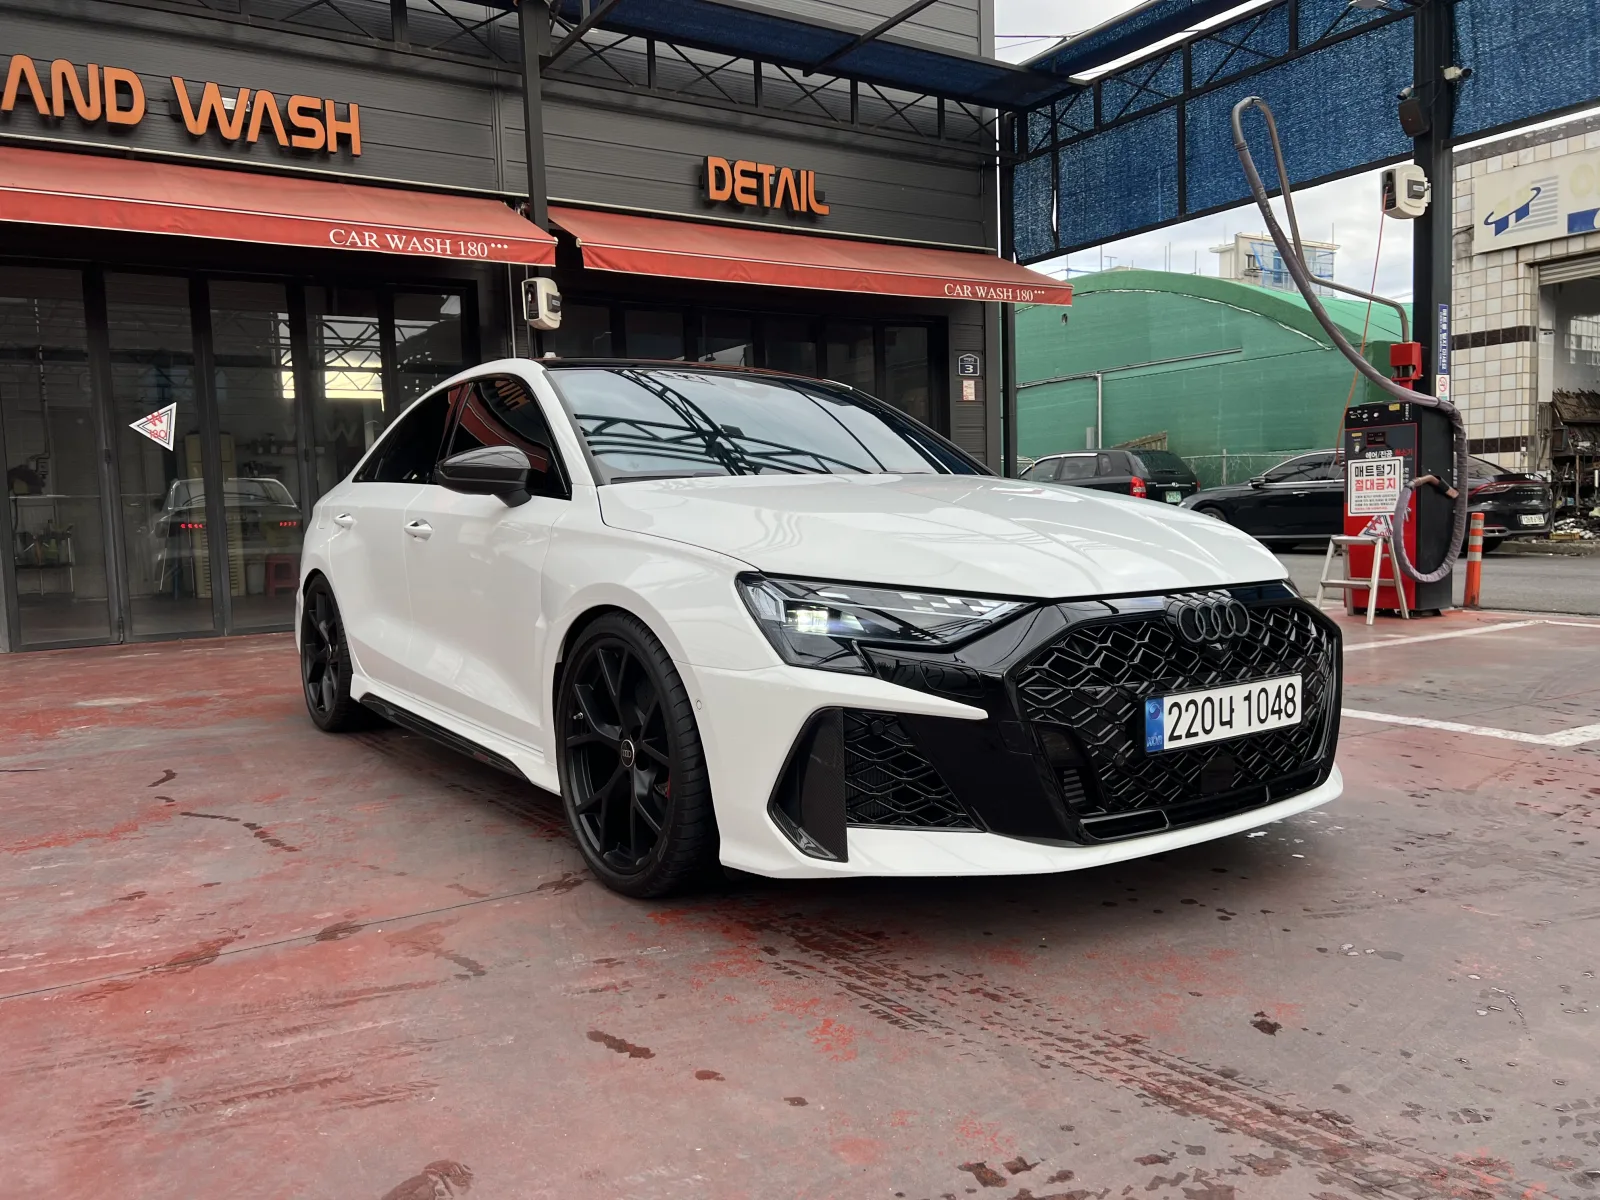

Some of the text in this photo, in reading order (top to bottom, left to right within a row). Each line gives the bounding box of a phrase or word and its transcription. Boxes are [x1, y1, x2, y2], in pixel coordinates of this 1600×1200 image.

[1, 54, 362, 156] AND WASH
[706, 156, 830, 215] DETAIL
[329, 228, 380, 249] CAR
[385, 233, 452, 255] WASH
[944, 283, 972, 298] CAR
[975, 285, 1013, 300] WASH
[964, 364, 974, 374] 3
[1354, 463, 1396, 478] 매트털기
[1354, 477, 1396, 492] 절대금지
[1168, 682, 1297, 742] 220나 1048
